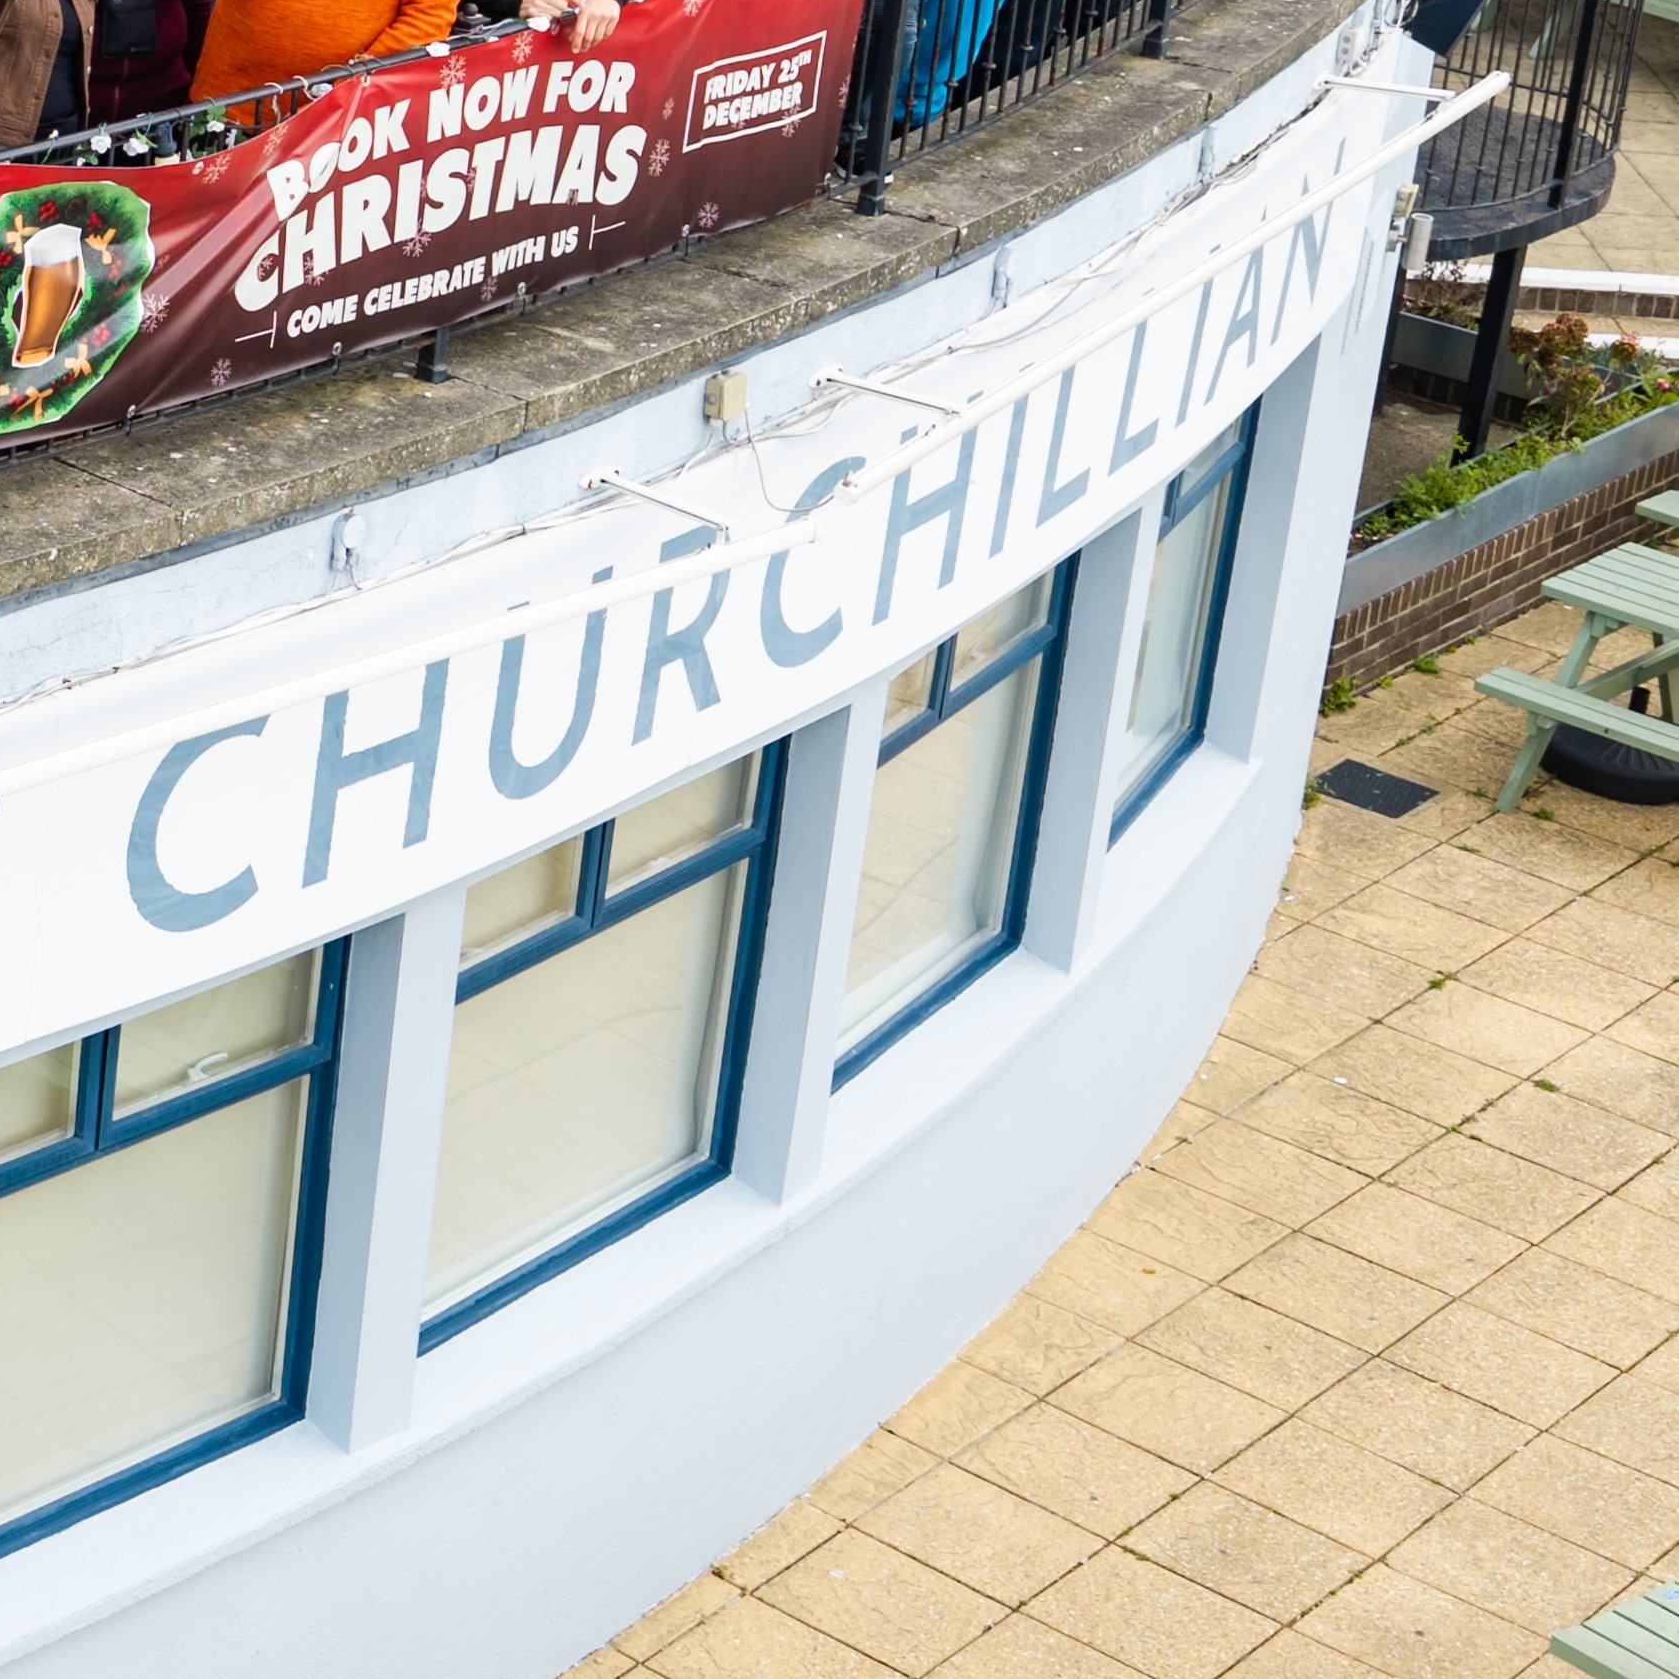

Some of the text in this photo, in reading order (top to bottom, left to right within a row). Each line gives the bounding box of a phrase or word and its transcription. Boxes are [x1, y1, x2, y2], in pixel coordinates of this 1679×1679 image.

[265, 58, 634, 223] BOOK NOW FOR
[701, 60, 775, 107] FRIDAY
[702, 81, 803, 130] DECEMBER
[234, 123, 648, 312] CHRISTMAS
[287, 224, 580, 339] COME CELEBRATE WITH US
[124, 136, 1347, 931] CHURCHILLIAN
